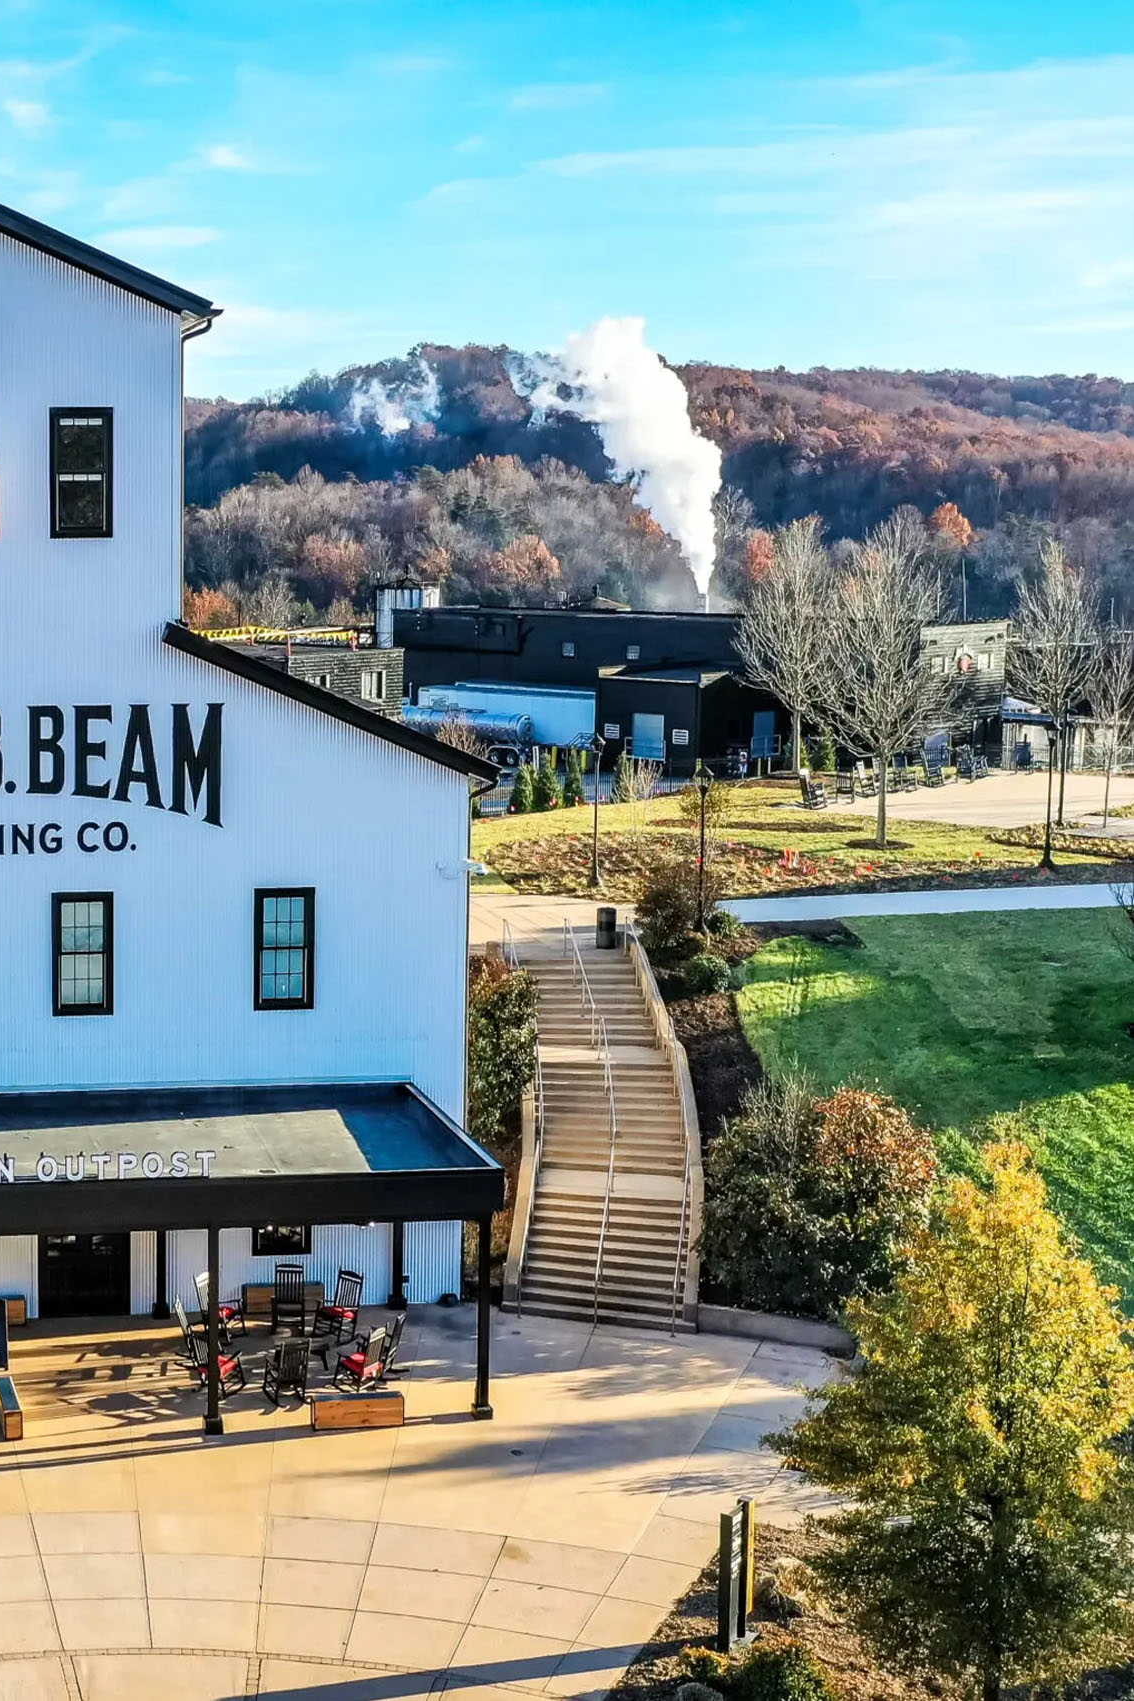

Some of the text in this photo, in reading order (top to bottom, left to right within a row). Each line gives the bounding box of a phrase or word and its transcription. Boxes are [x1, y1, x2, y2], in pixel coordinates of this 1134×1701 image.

[26, 702, 226, 829] BEAM
[76, 820, 138, 853] CO.
[36, 1150, 217, 1183] OUTPOST
